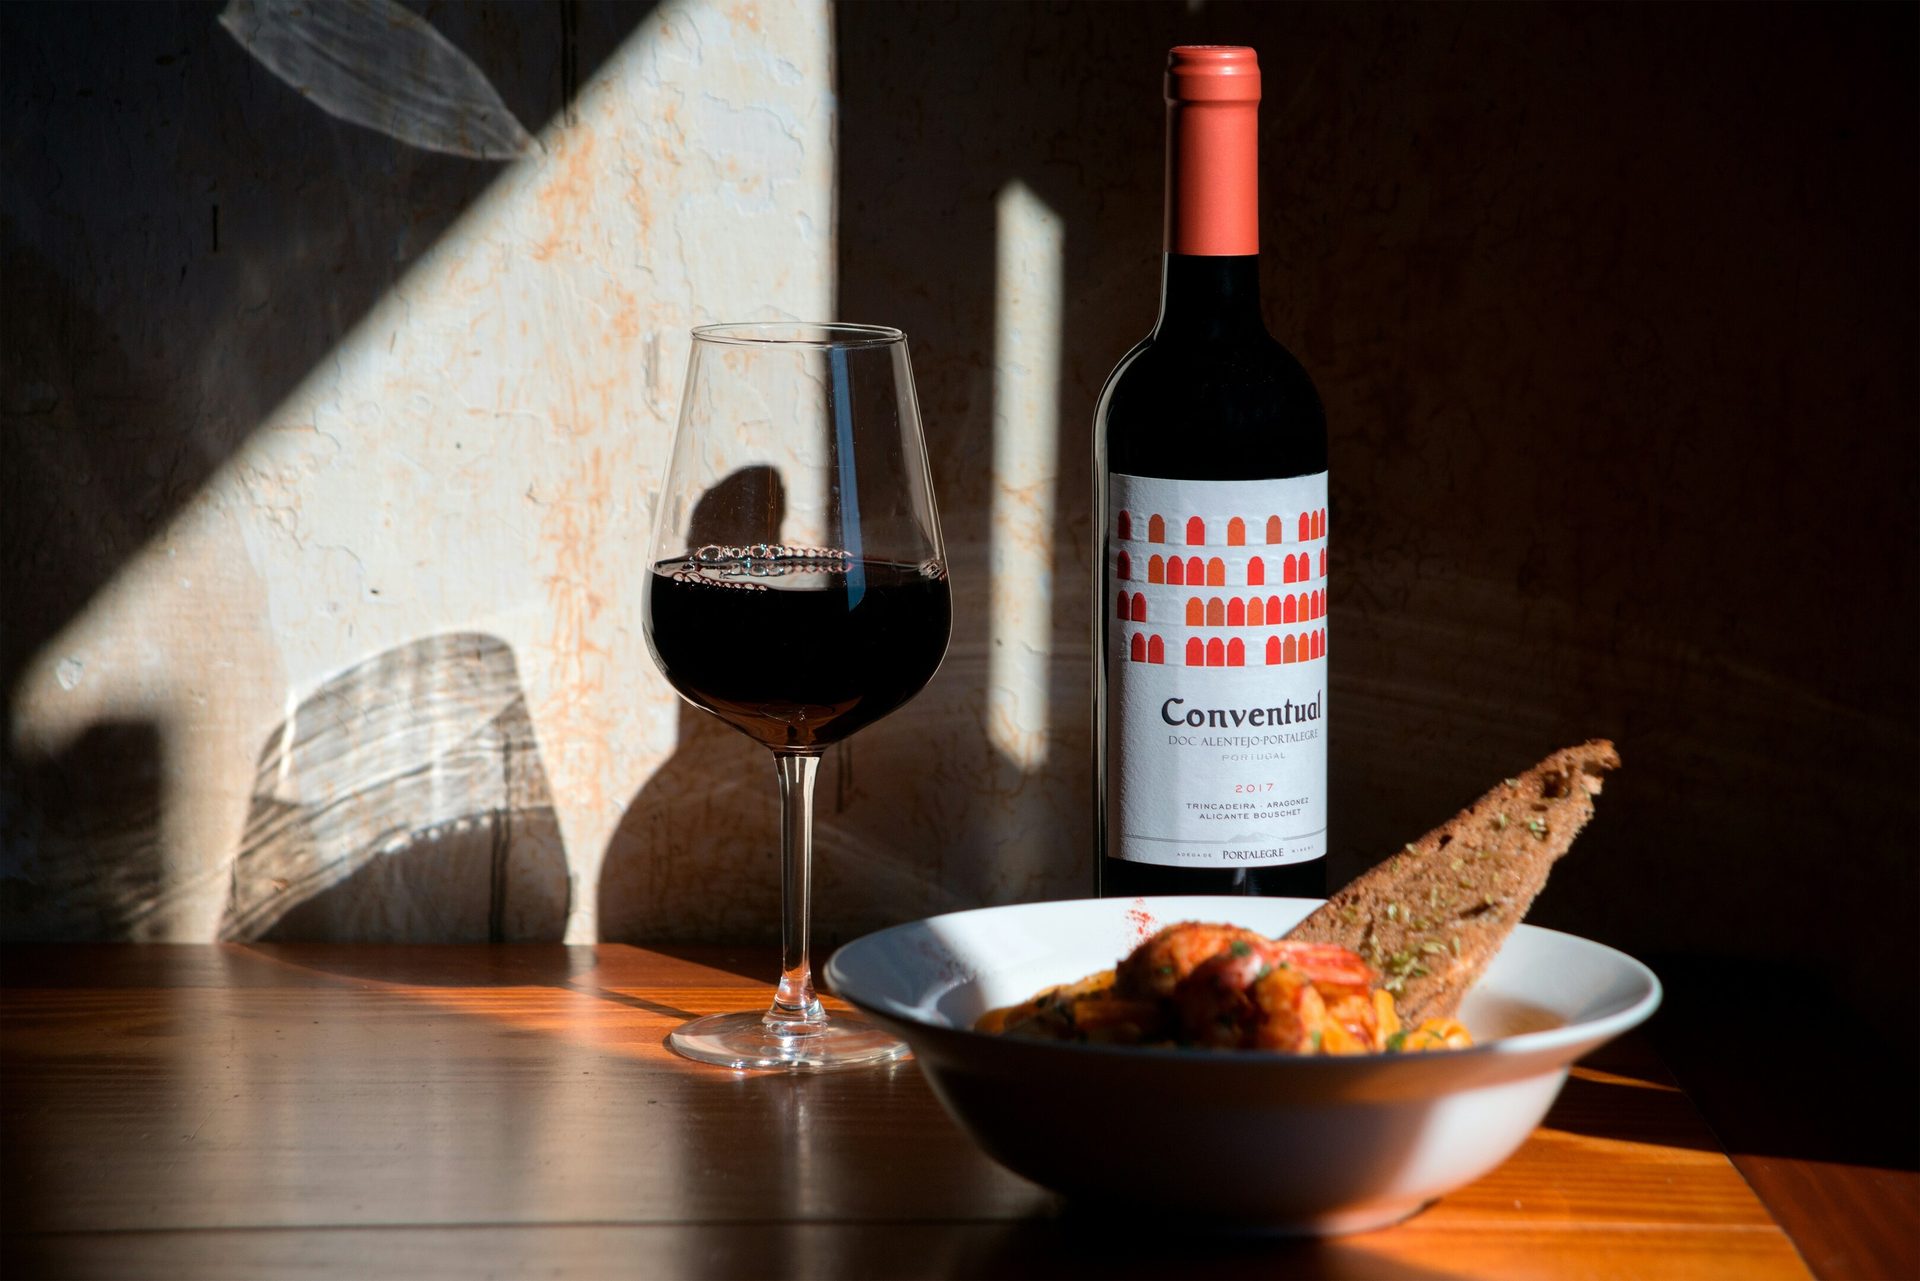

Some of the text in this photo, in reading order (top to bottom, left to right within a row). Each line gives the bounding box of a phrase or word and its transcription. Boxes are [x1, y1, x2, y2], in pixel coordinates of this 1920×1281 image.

[1161, 689, 1321, 728] Conventual
[1168, 735, 1197, 746] DOC
[1222, 752, 1286, 762] PORTUGAL
[1235, 783, 1274, 793] 2017
[1186, 797, 1309, 811] TRINCADEIRA ARAGONEZ
[1253, 809, 1301, 819] BOUSCHET
[1222, 848, 1284, 860] PORTALEGRE
